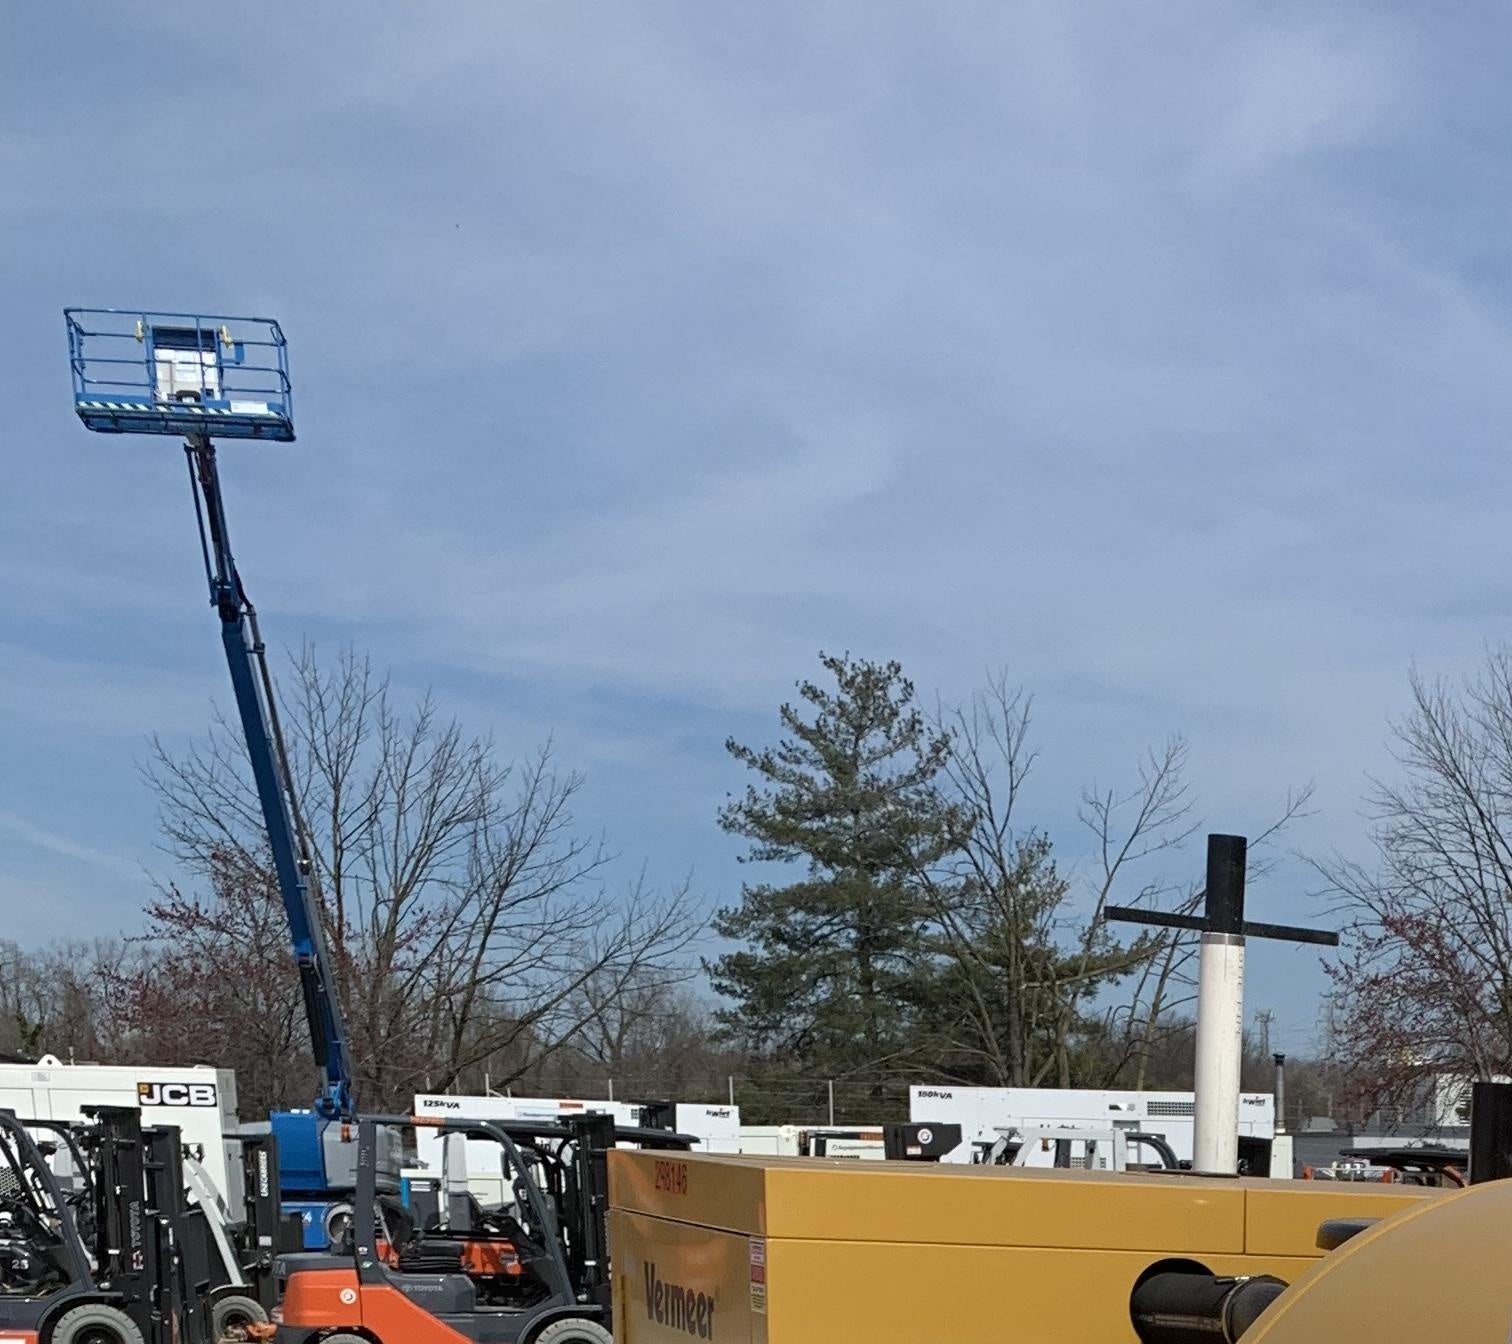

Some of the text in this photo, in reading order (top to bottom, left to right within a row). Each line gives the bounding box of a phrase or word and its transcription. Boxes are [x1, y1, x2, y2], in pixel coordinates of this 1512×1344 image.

[139, 1084, 216, 1106] JCB
[655, 1160, 688, 1195] 298146
[129, 1200, 142, 1249] TOYOTA
[644, 1261, 715, 1340] Vermeer
